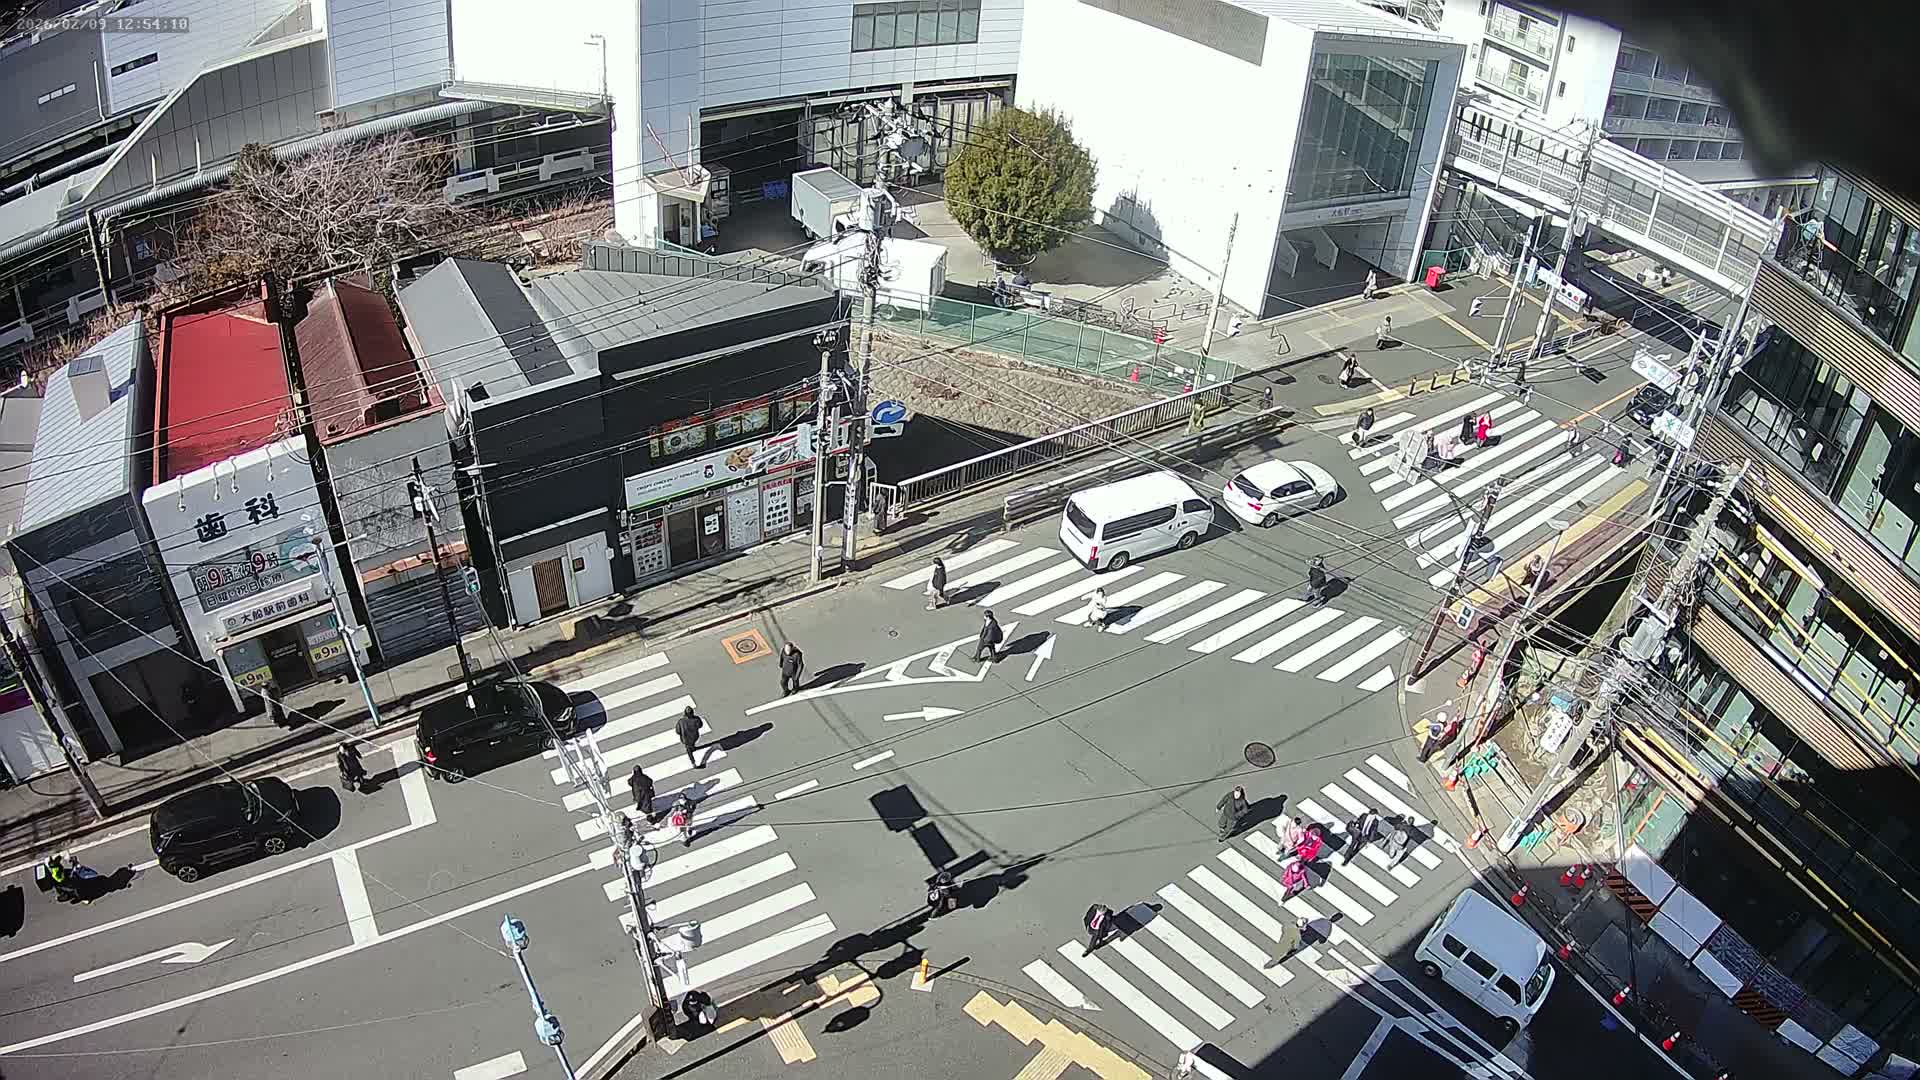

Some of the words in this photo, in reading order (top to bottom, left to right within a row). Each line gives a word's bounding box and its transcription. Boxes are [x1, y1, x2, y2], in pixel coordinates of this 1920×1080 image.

[194, 493, 279, 542] 歯科
[241, 591, 310, 624] 大船駅前歯科
